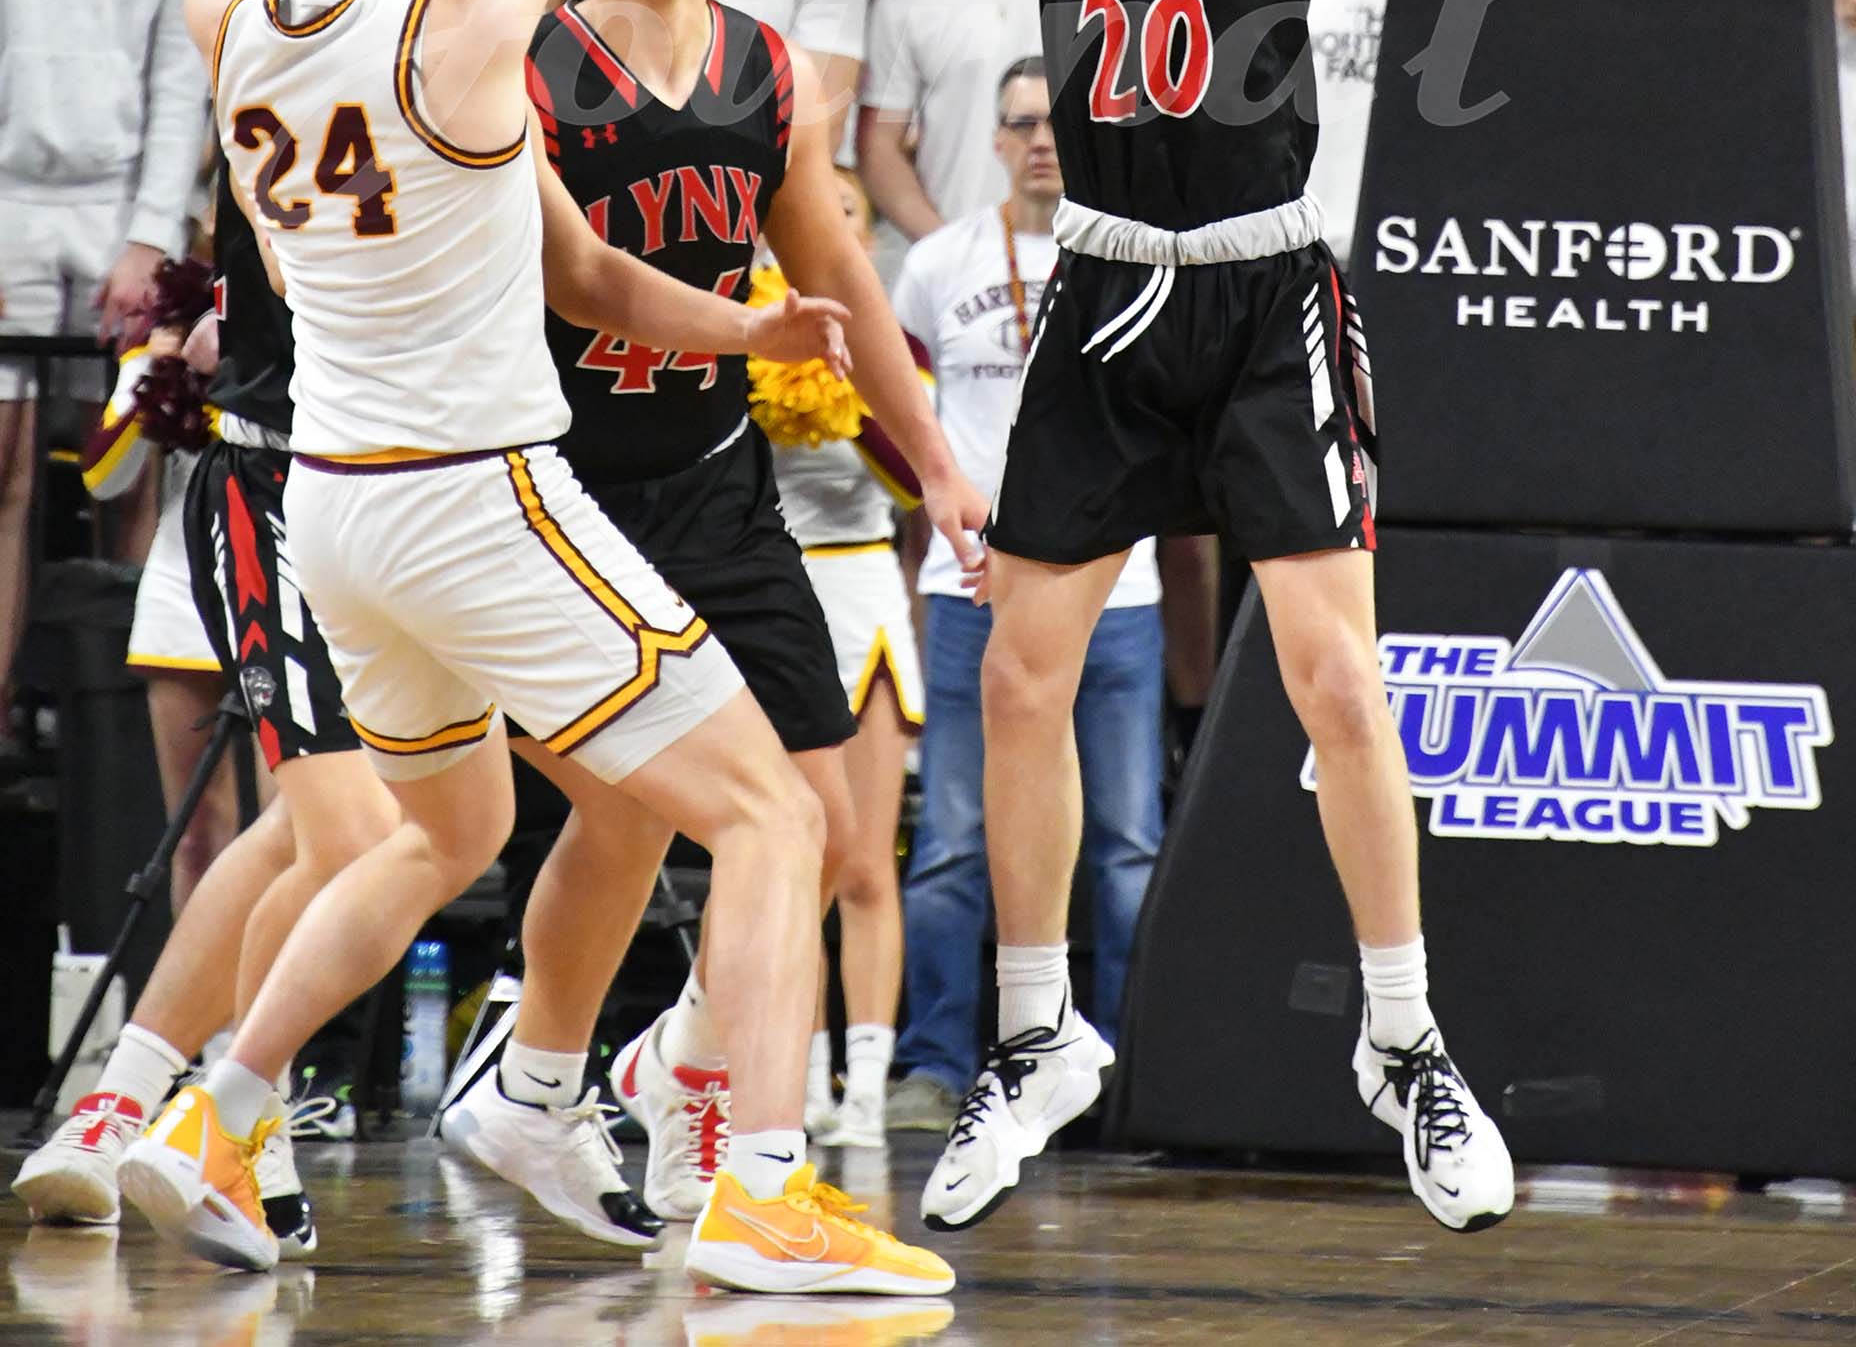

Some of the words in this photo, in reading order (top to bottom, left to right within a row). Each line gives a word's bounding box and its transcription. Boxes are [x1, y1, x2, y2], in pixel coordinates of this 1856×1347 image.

[232, 102, 398, 239] 24
[585, 164, 762, 256] LYNX
[1376, 215, 1796, 284] SANFORD
[1456, 294, 1710, 333] HEALTH
[1384, 645, 1498, 676] THE
[1386, 690, 1808, 788] UMMIT
[1440, 795, 1705, 836] LEAGUE
